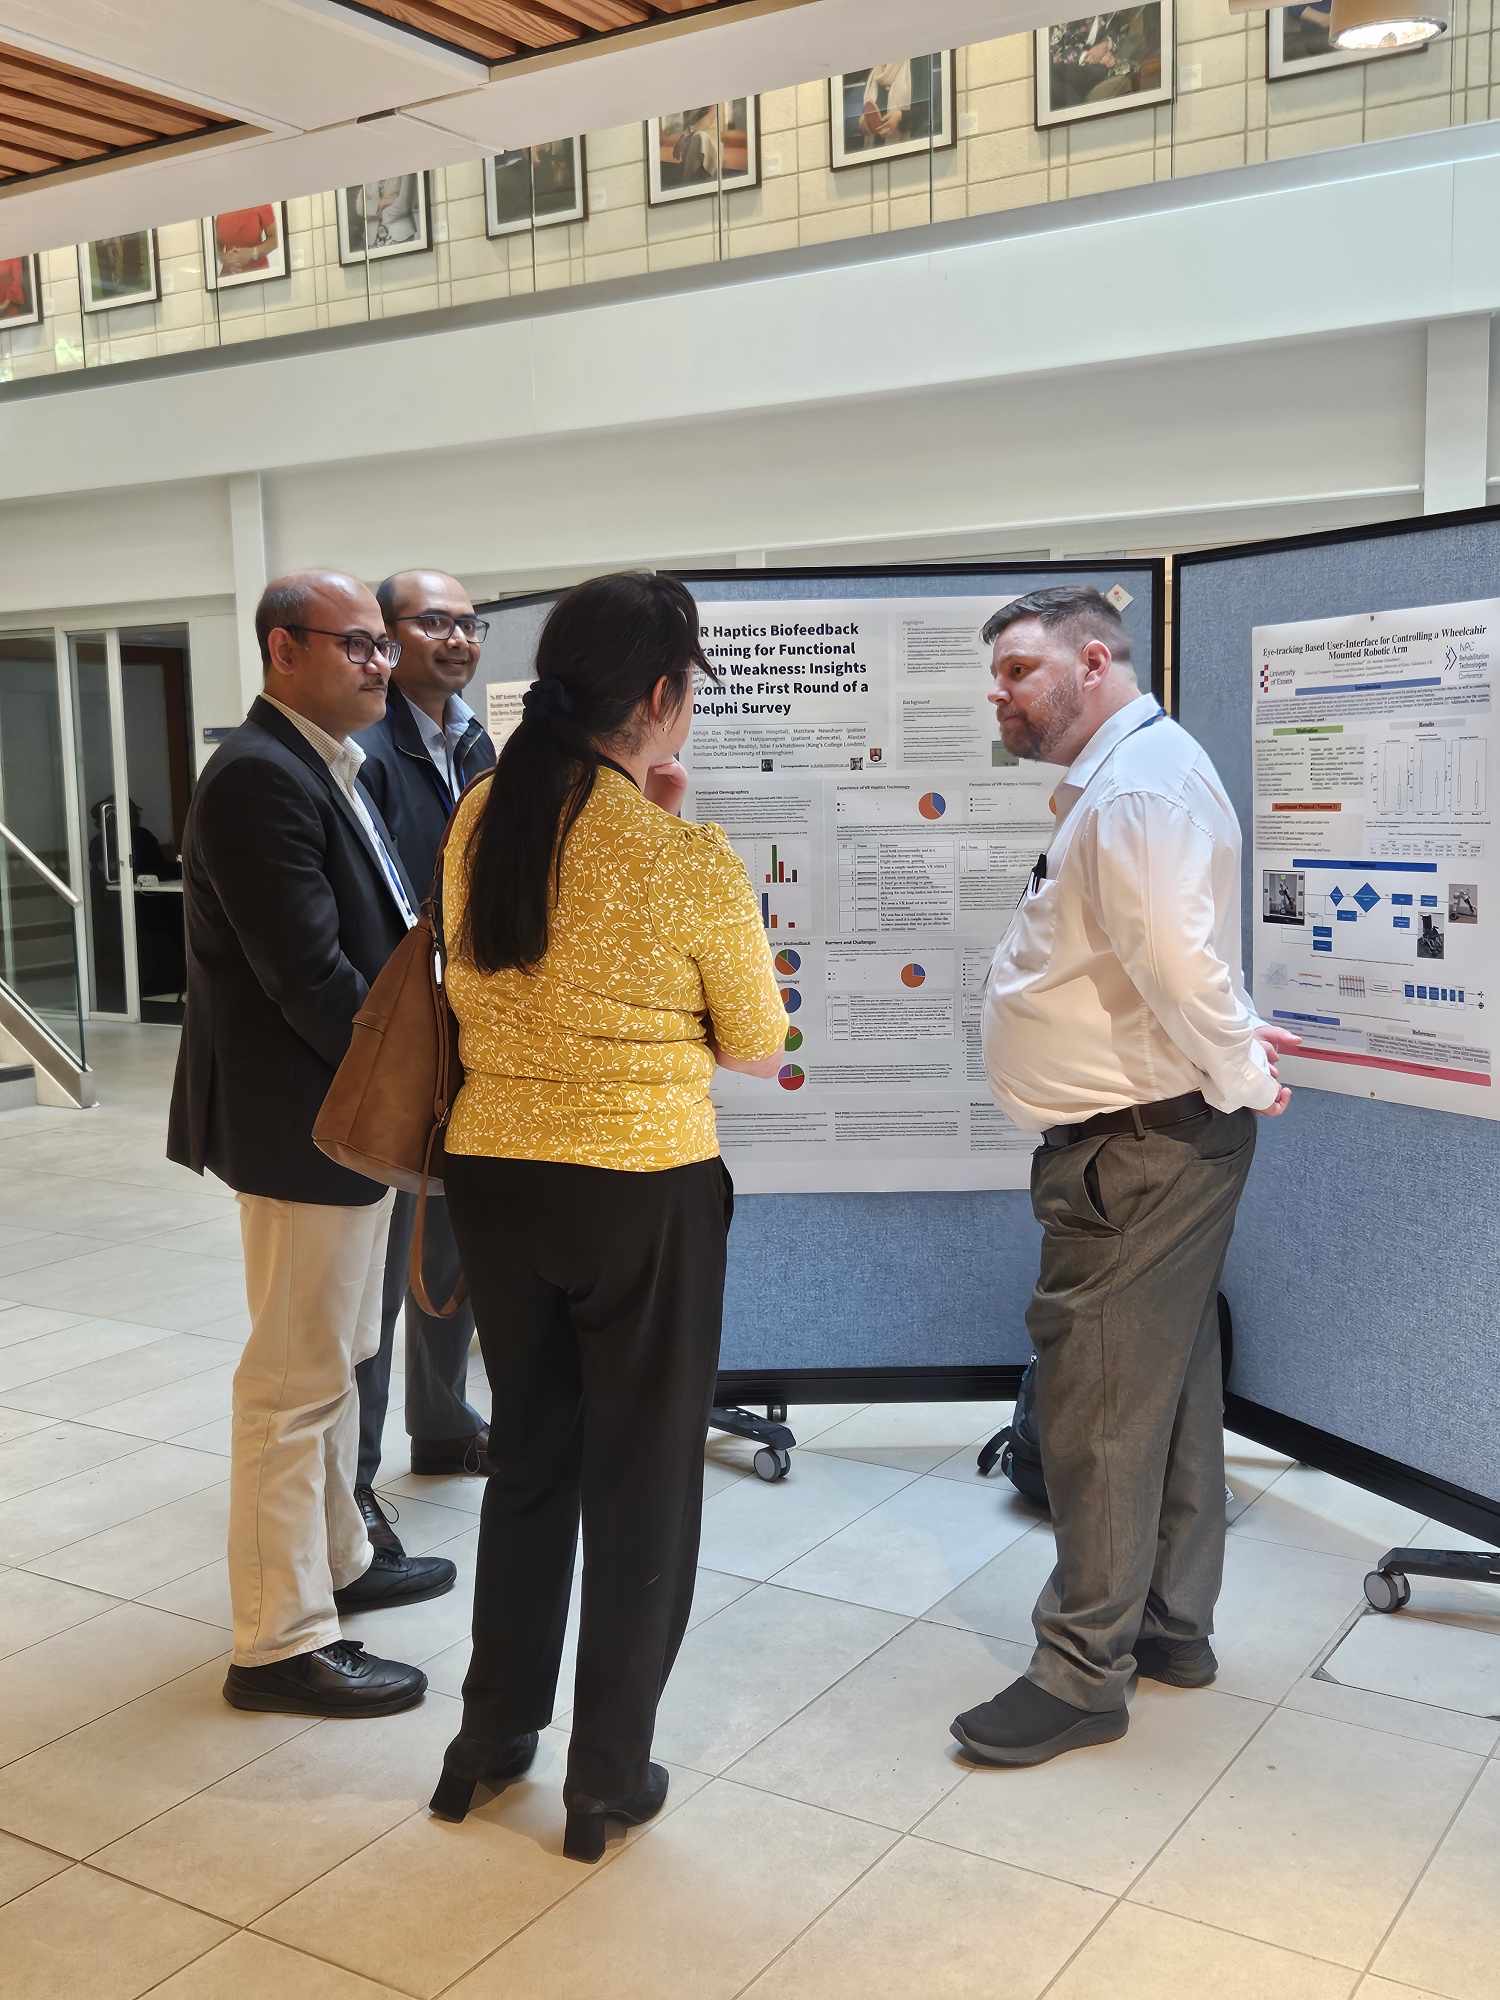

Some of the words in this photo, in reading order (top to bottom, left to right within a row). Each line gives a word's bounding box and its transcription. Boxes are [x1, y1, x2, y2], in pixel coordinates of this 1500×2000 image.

[699, 626, 710, 638] R
[713, 624, 767, 640] Haptics
[770, 622, 860, 637] Biofeedback
[1262, 645, 1304, 658] Eye-tracking
[1305, 642, 1325, 654] Based
[1327, 637, 1379, 651] User-Interface
[1380, 635, 1390, 646] for
[1391, 631, 1433, 644] Controlling
[1441, 624, 1488, 638] Wheelcahir
[703, 643, 752, 659] aining
[755, 643, 776, 657] for
[780, 642, 855, 656] Functional
[1328, 648, 1361, 661] Mounted
[1363, 645, 1391, 658] Robotic
[1391, 644, 1408, 656] Arm
[730, 663, 806, 676] Weakness:
[810, 660, 867, 677] Insights
[1269, 669, 1296, 678] University
[729, 683, 754, 696] the
[757, 682, 791, 695] First
[793, 680, 840, 694] Round
[842, 680, 858, 693] of
[861, 682, 870, 693] a
[1277, 678, 1293, 686] Essex
[693, 702, 738, 718] Delphi
[741, 703, 792, 718] Survey
